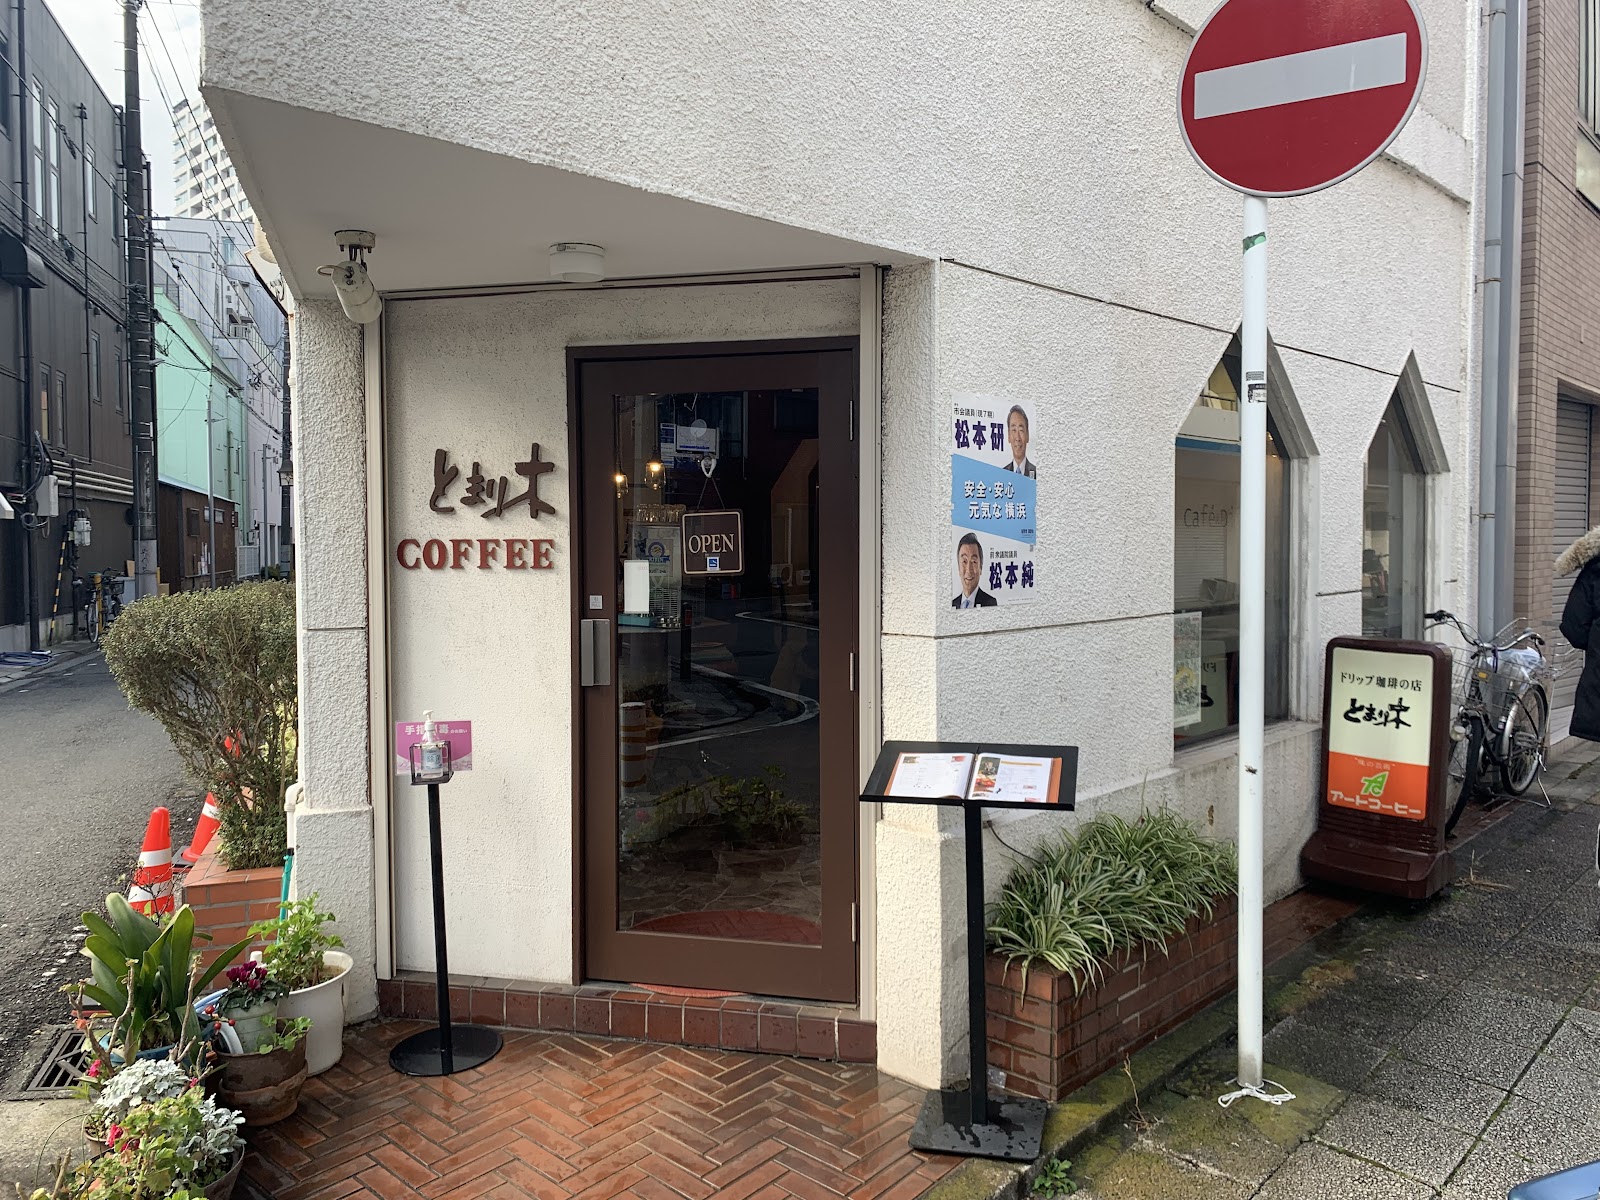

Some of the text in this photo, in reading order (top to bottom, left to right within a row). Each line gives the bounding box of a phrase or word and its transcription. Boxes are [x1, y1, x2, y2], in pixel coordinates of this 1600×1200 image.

[954, 418, 1004, 452] 松本研
[429, 442, 557, 519] とまり木
[964, 480, 1015, 499] 安全・安心
[396, 538, 556, 571] COFFEE
[688, 533, 735, 554] OPEN
[989, 560, 1034, 590] 松本純
[1340, 672, 1422, 692] ドリップ珈琲の店
[1343, 697, 1412, 729] とまり木
[1330, 790, 1422, 815] アートコーヒー
